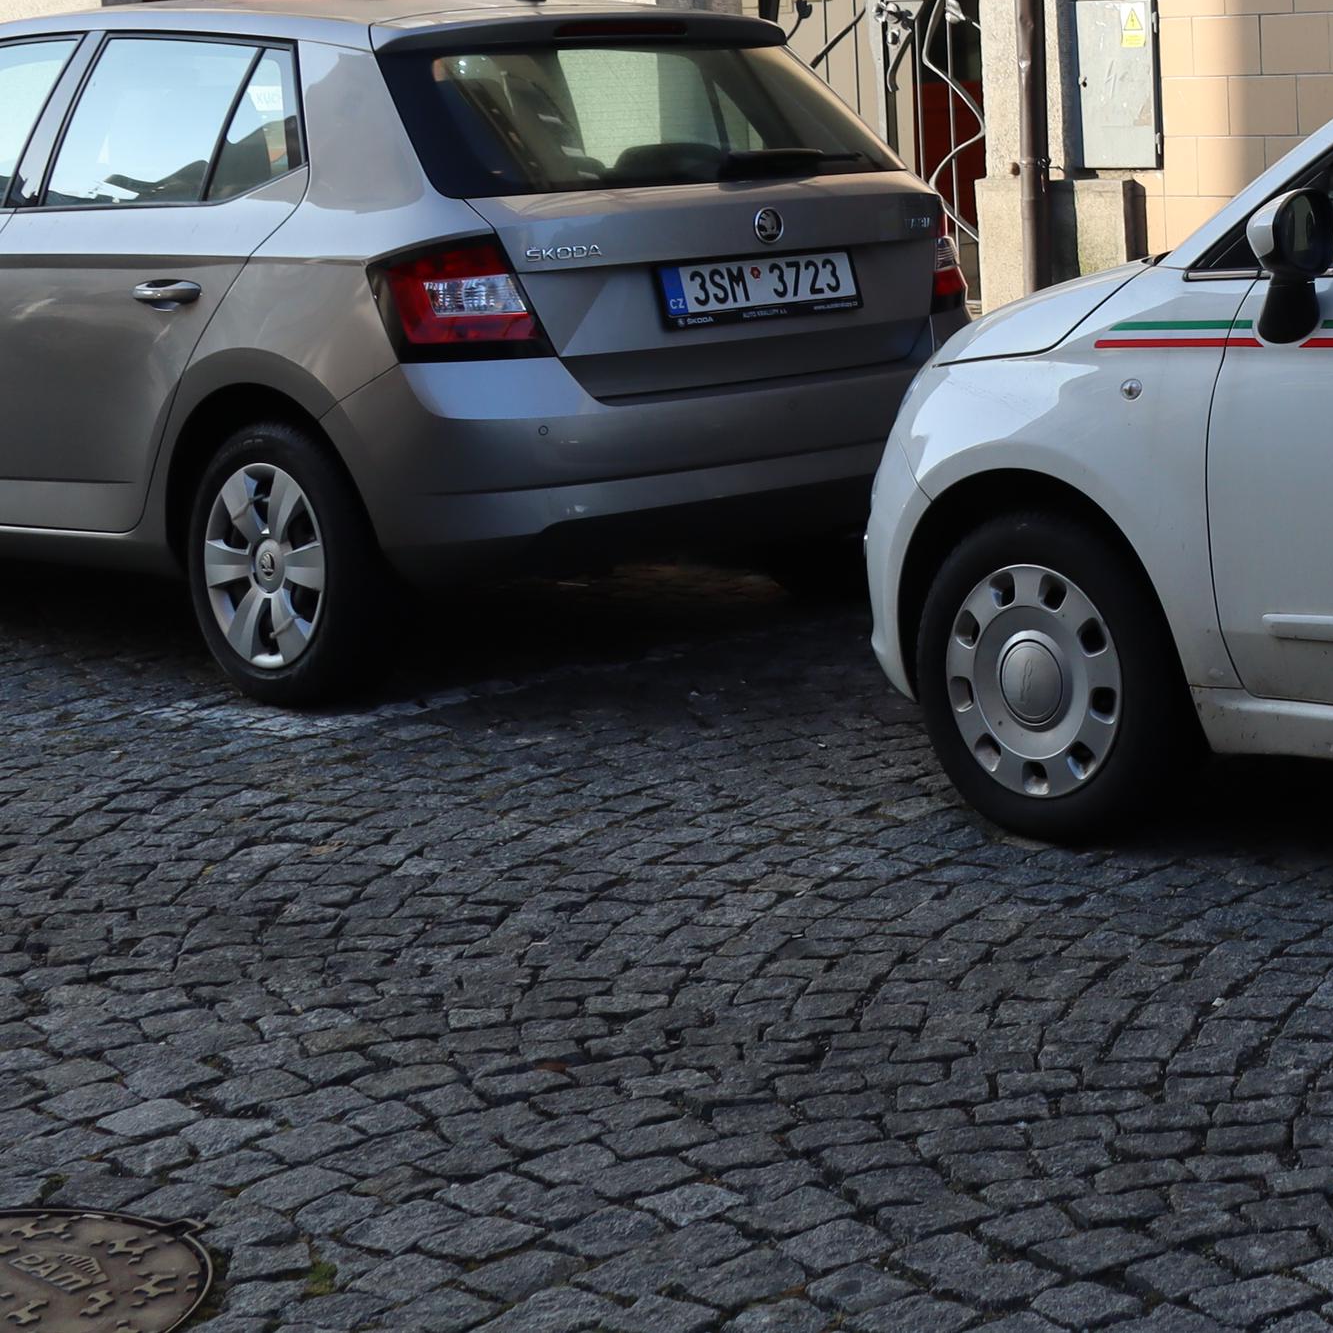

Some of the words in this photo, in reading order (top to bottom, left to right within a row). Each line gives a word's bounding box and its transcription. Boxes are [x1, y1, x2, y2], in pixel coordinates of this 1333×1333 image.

[525, 243, 602, 262] ŠKODA
[688, 266, 751, 307] 3SM
[767, 257, 842, 299] 3723
[669, 298, 685, 310] CZ
[686, 316, 714, 325] ŠKODA
